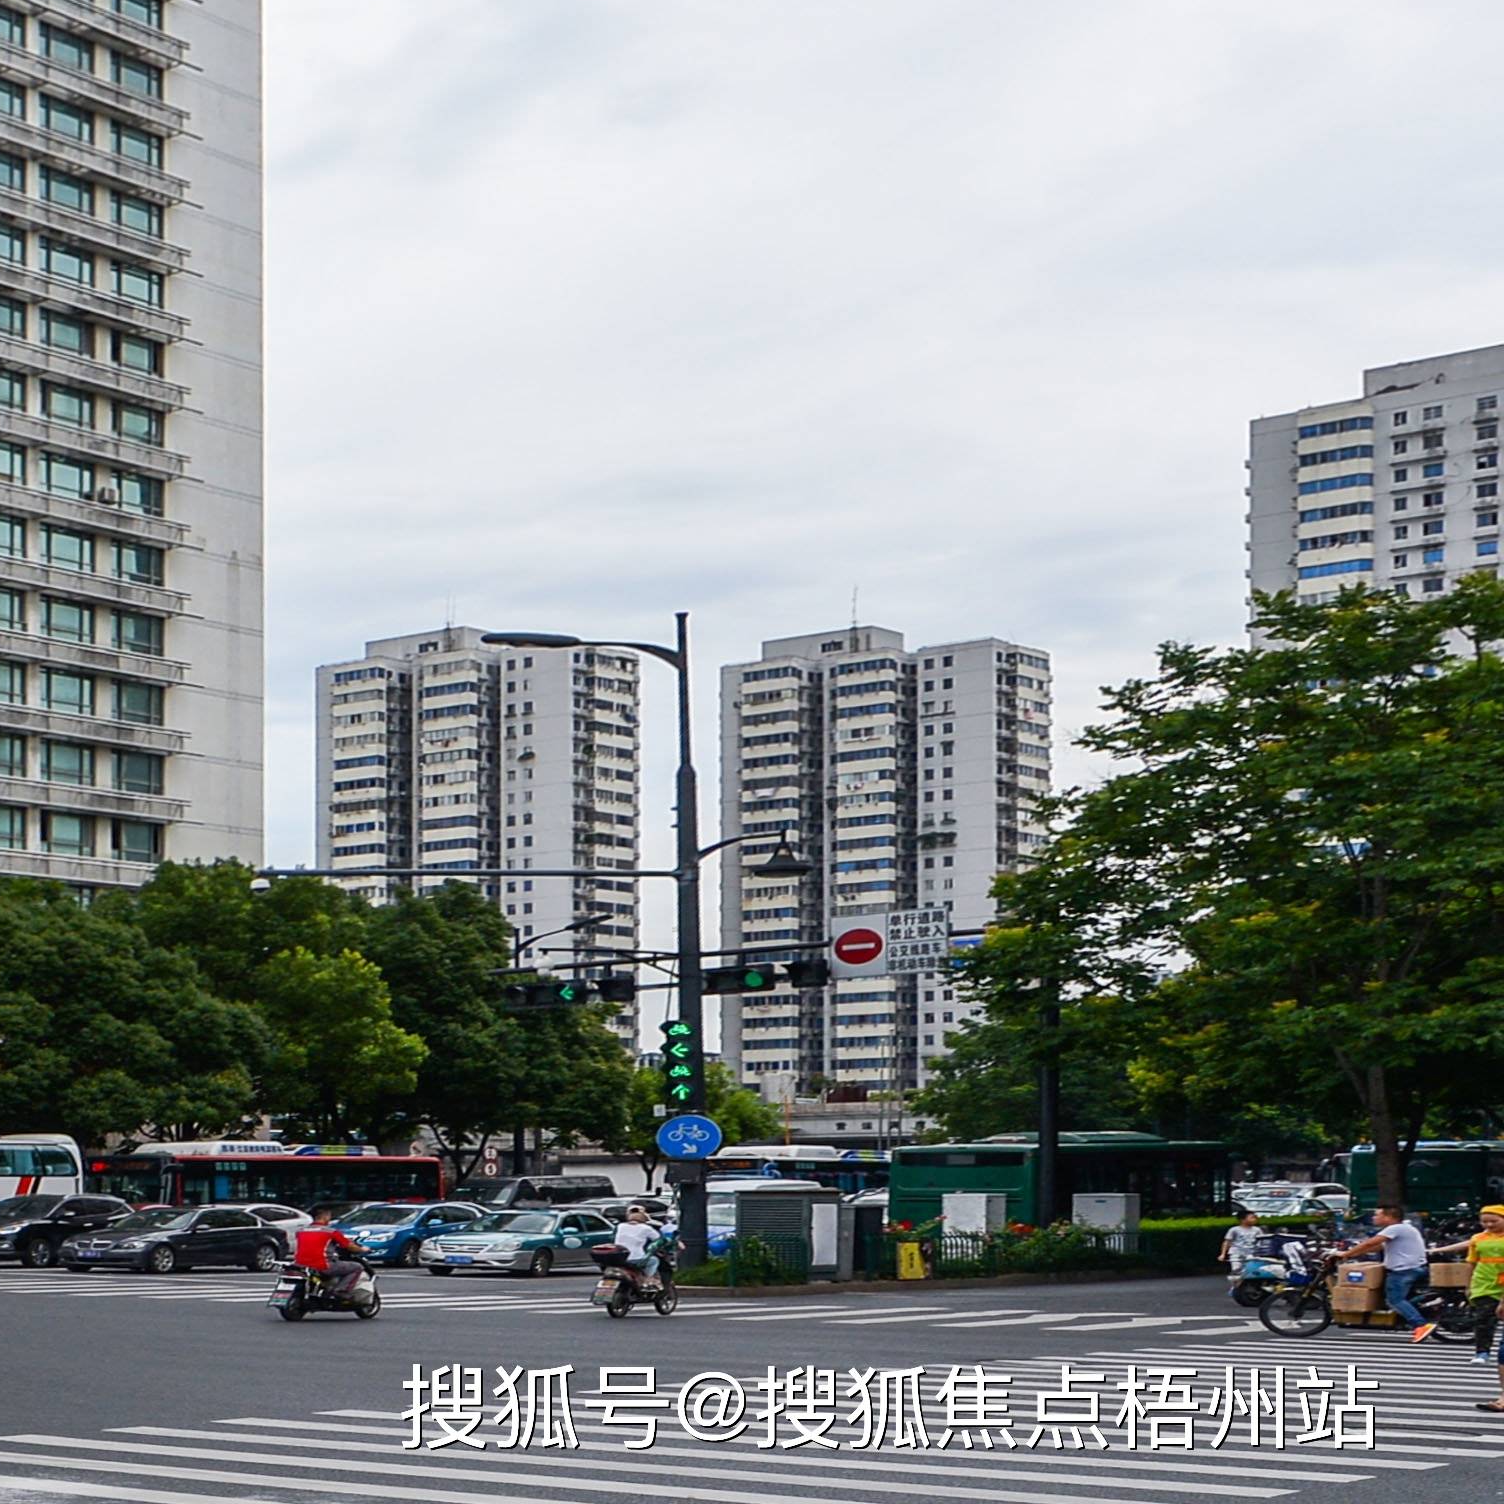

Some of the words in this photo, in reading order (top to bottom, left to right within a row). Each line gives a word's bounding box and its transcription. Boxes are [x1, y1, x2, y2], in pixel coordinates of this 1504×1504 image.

[890, 910, 945, 926] 单行道路
[890, 925, 945, 940] 禁止驶入
